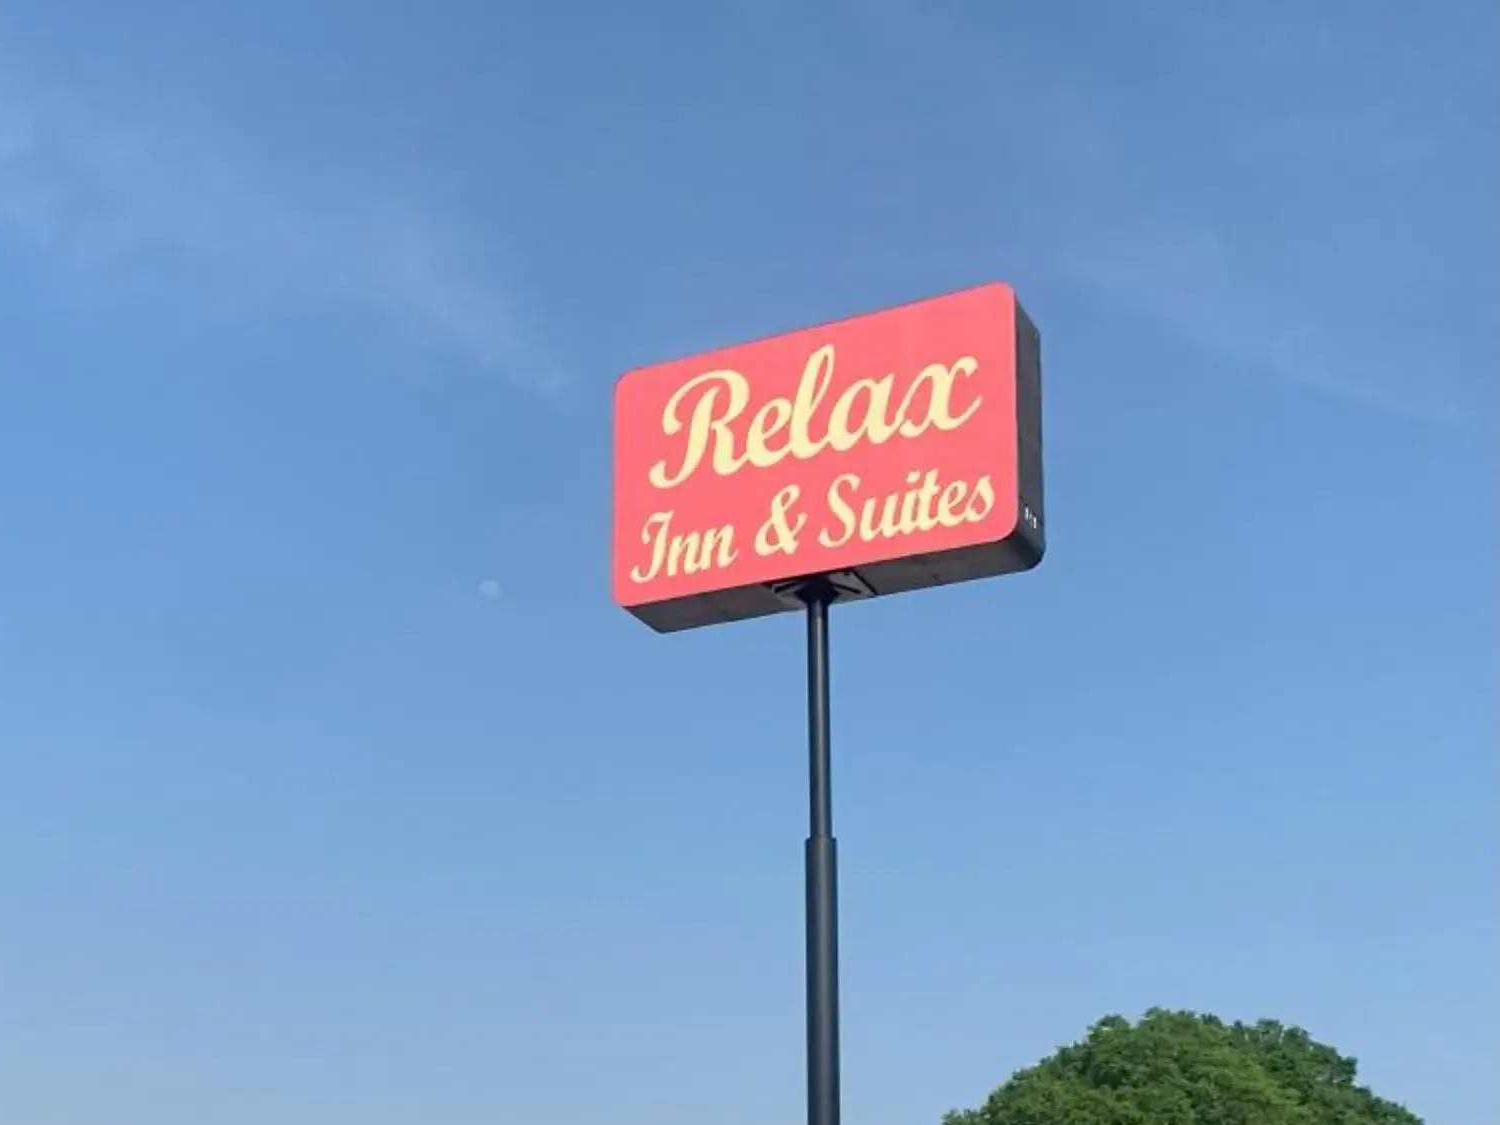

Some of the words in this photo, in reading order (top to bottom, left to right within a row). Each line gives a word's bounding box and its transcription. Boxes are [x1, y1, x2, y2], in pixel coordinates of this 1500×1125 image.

[648, 343, 983, 488] Relax
[629, 509, 739, 584] Inn
[754, 484, 807, 556] &
[817, 469, 995, 549] Suites
